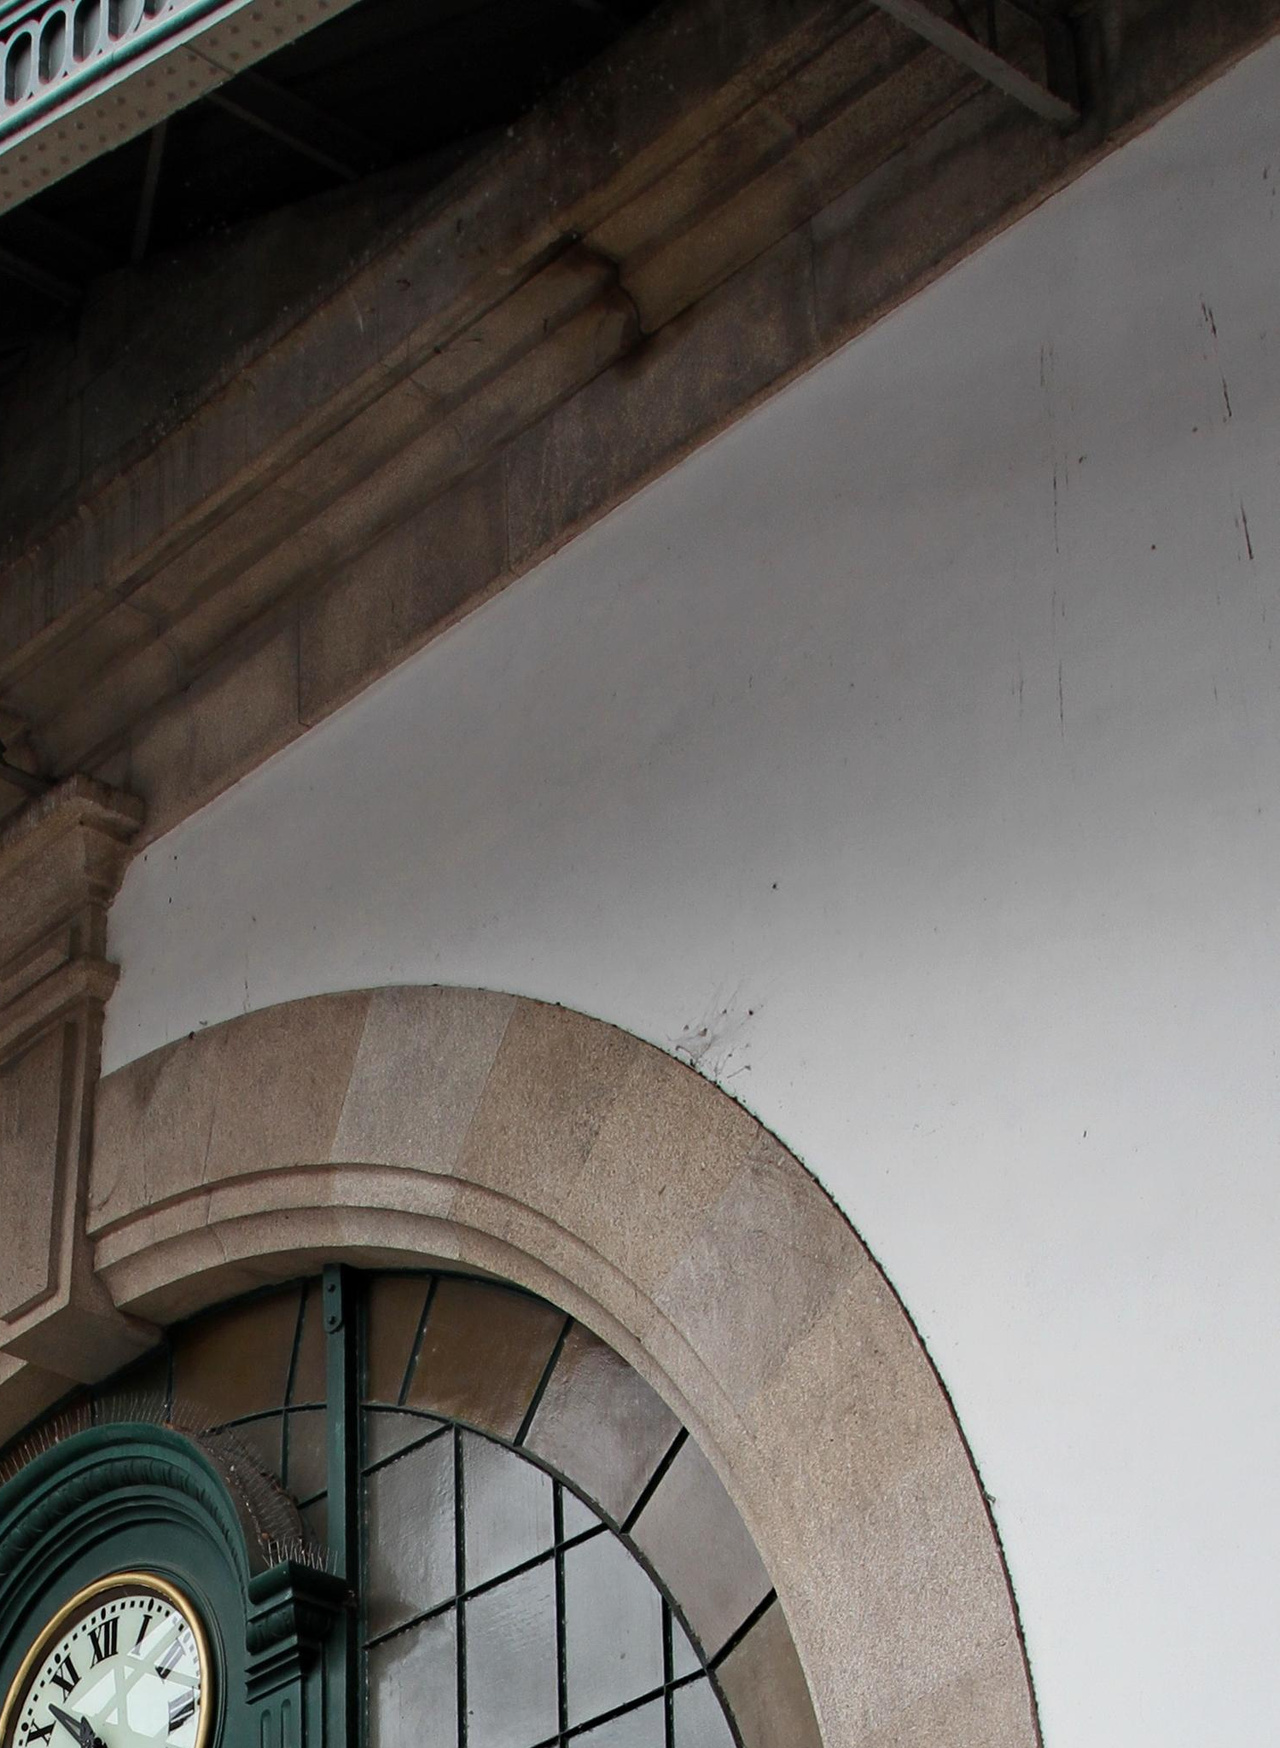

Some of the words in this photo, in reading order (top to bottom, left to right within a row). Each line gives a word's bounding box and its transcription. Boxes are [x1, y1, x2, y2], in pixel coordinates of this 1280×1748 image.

[88, 1617, 120, 1669] XII
[131, 1614, 153, 1655] I
[50, 1655, 81, 1702] XI
[26, 1720, 56, 1746] X
